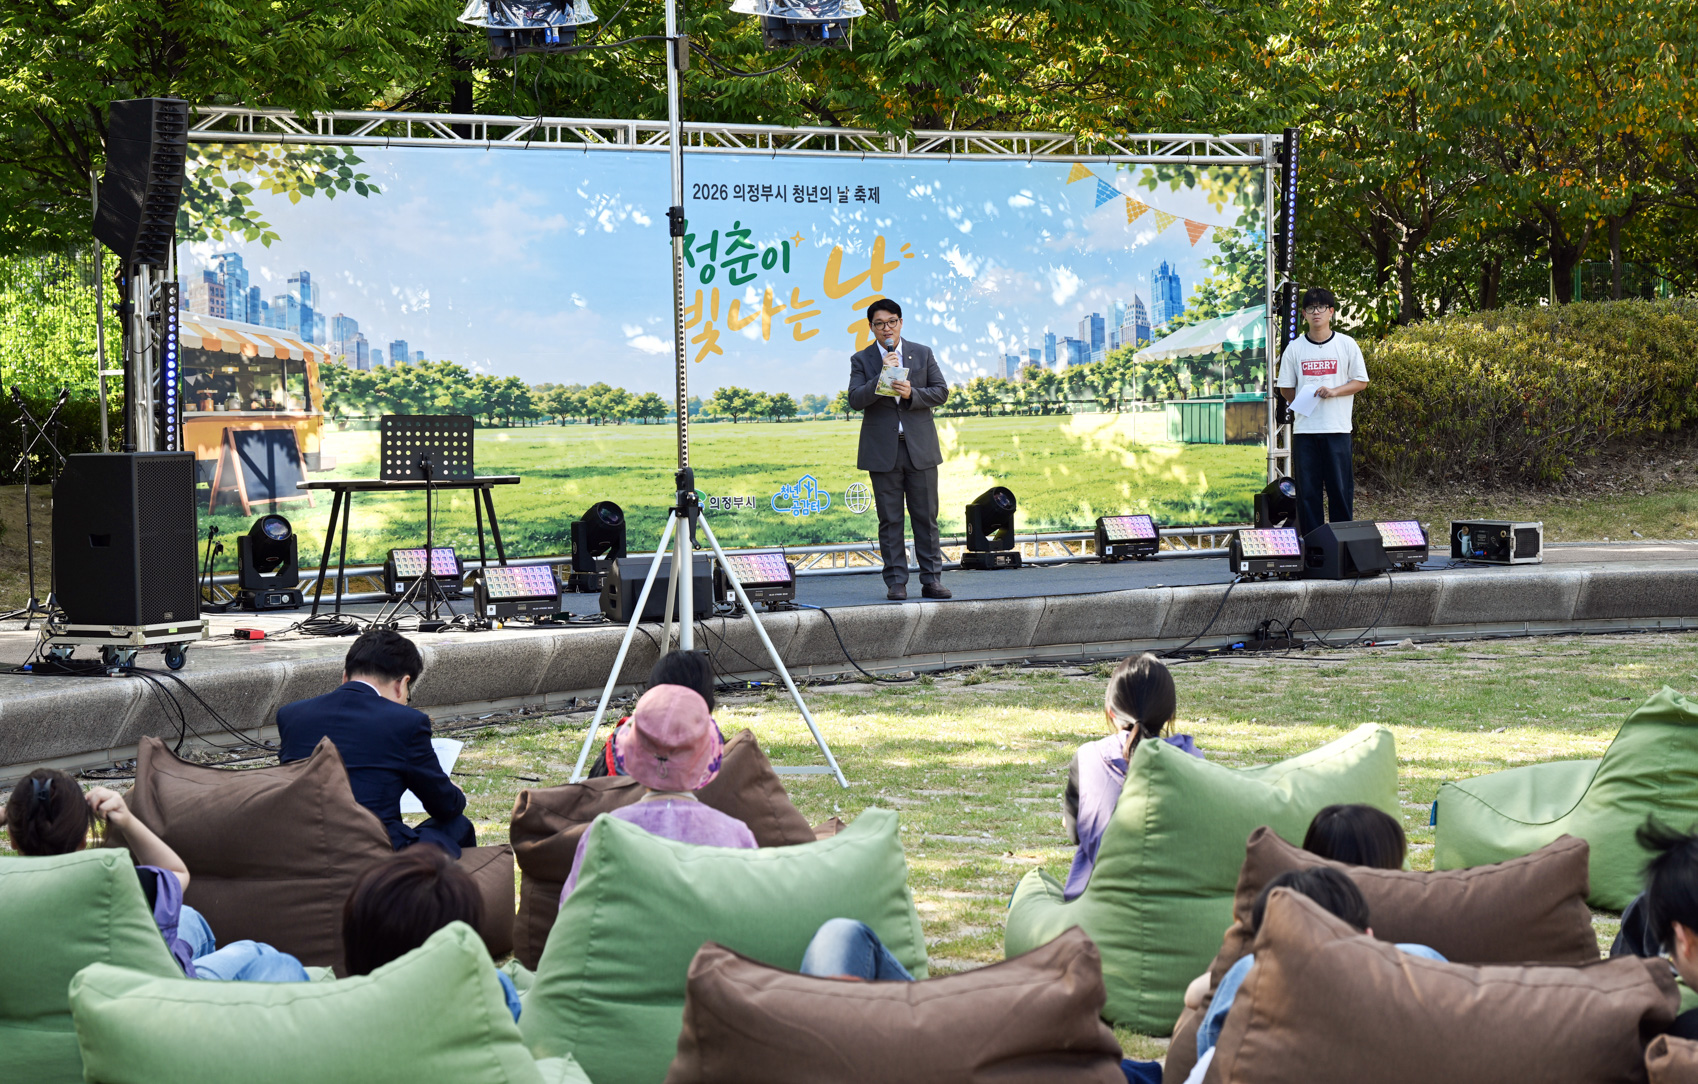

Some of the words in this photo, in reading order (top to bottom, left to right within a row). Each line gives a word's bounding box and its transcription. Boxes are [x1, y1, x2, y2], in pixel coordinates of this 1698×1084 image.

[692, 183, 728, 201] 2026
[733, 183, 787, 203] 의정부시
[792, 184, 832, 204] 청년의
[837, 185, 850, 204] 날
[854, 184, 881, 205] 축제
[670, 219, 790, 286] 청춘이
[683, 286, 821, 363] 빛나는
[1302, 361, 1337, 371] CHERRY
[780, 484, 799, 500] 청년
[709, 495, 756, 510] 의정부시
[791, 499, 820, 517] 공감터
